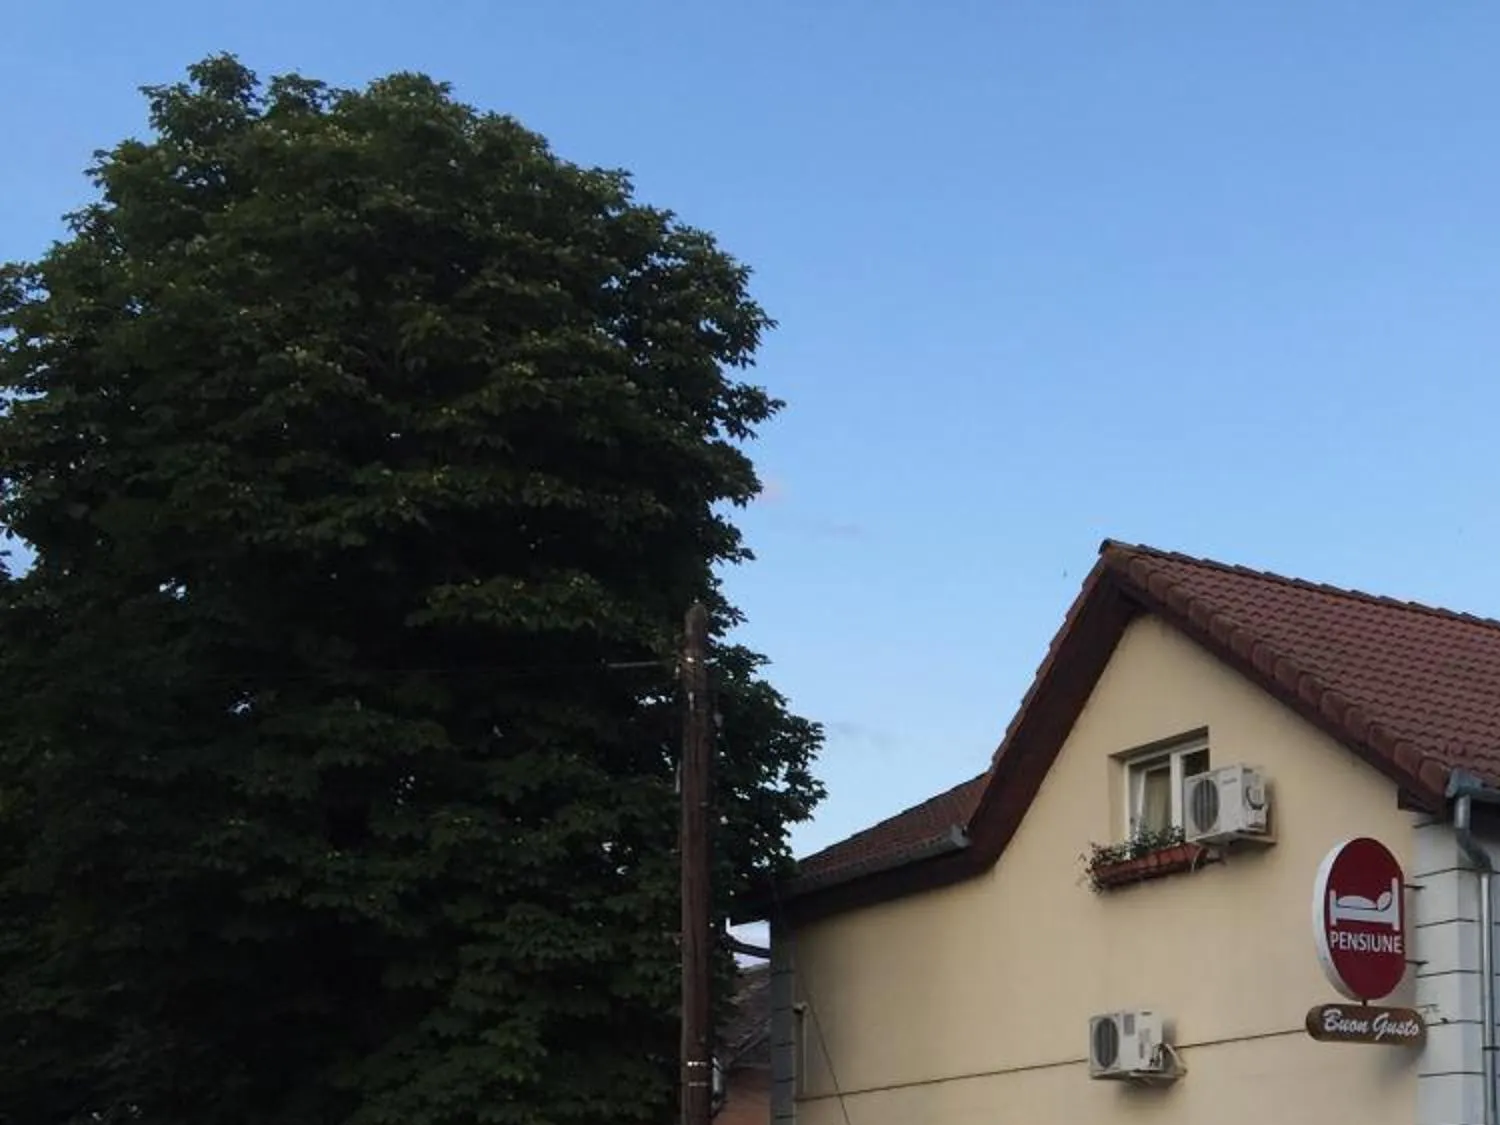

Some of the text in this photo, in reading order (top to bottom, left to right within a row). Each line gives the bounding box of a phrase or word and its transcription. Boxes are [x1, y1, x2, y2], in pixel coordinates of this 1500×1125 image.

[1329, 930, 1403, 954] PENSIUNE
[1322, 1008, 1420, 1040] Buon Gusto
